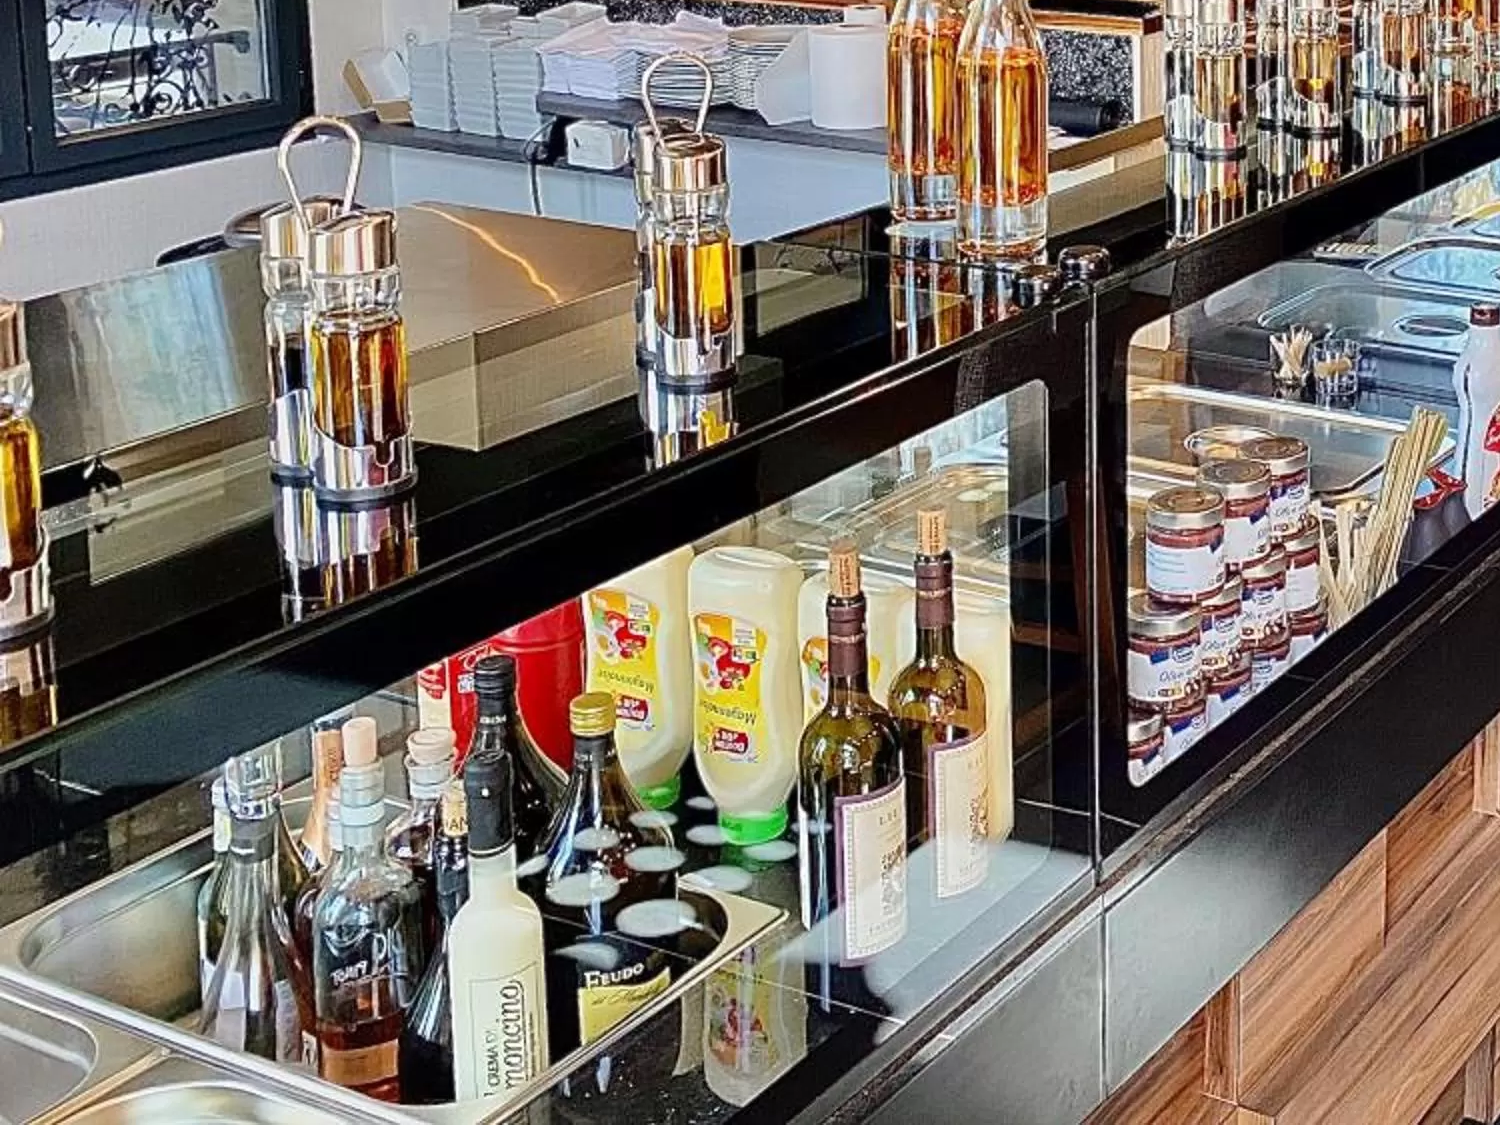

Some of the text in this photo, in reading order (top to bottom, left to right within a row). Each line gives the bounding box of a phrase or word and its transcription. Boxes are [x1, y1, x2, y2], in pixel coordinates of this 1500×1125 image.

[584, 962, 645, 991] FEUDO
[496, 982, 525, 1091] moncino
[486, 1045, 500, 1087] CREMA
